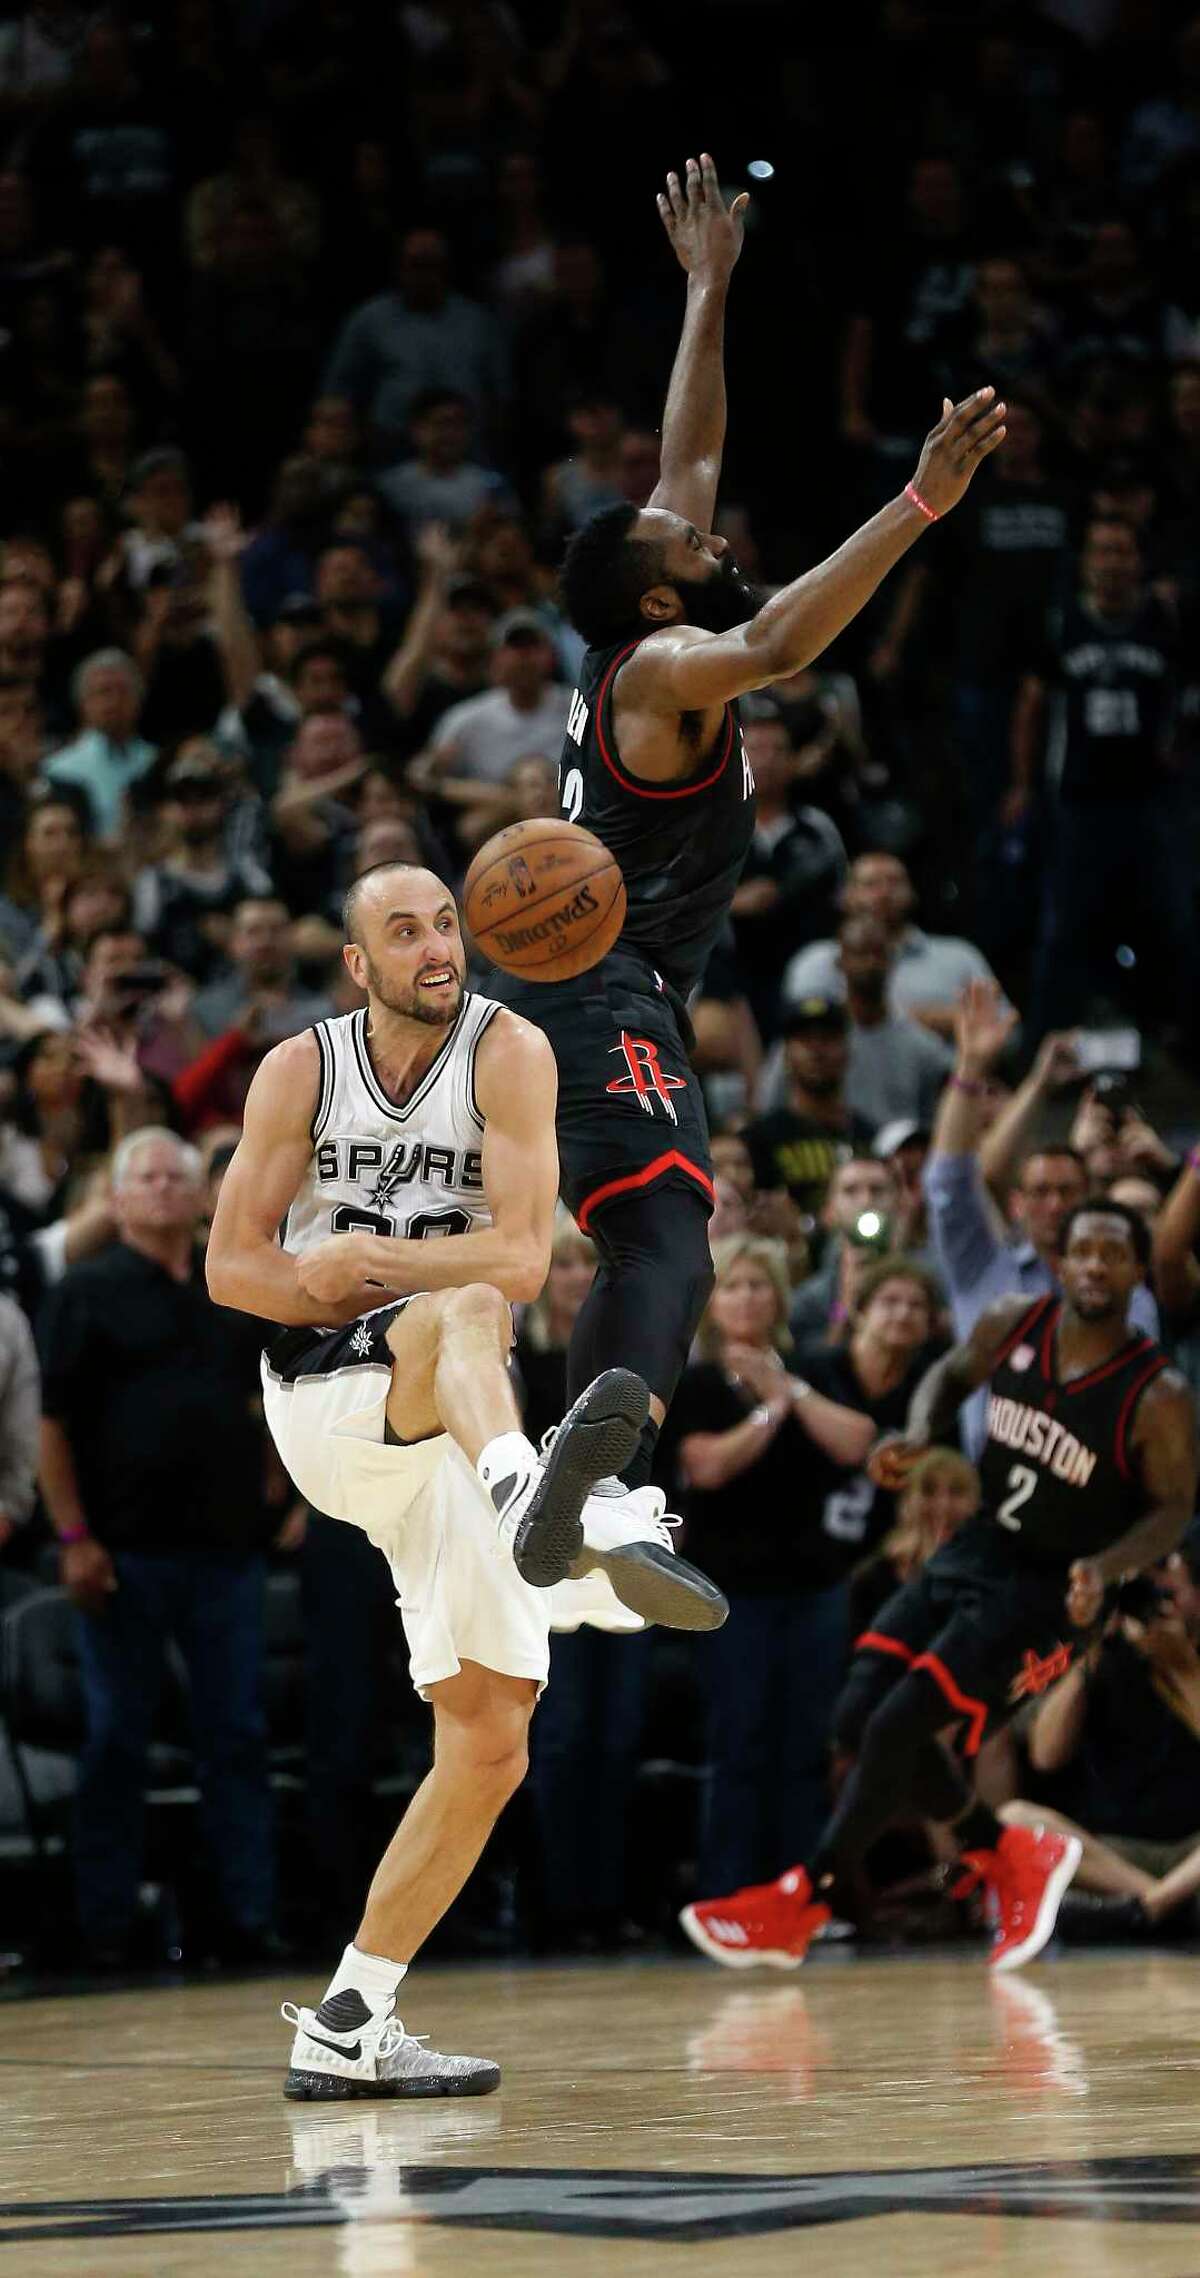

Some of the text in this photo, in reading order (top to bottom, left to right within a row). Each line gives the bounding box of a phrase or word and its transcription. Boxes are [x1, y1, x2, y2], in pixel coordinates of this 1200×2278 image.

[493, 885, 599, 955] SPALDING
[317, 1142, 483, 1190] SPURS
[987, 1393, 1099, 1488] HOUSTON
[995, 1463, 1039, 1534] 2
